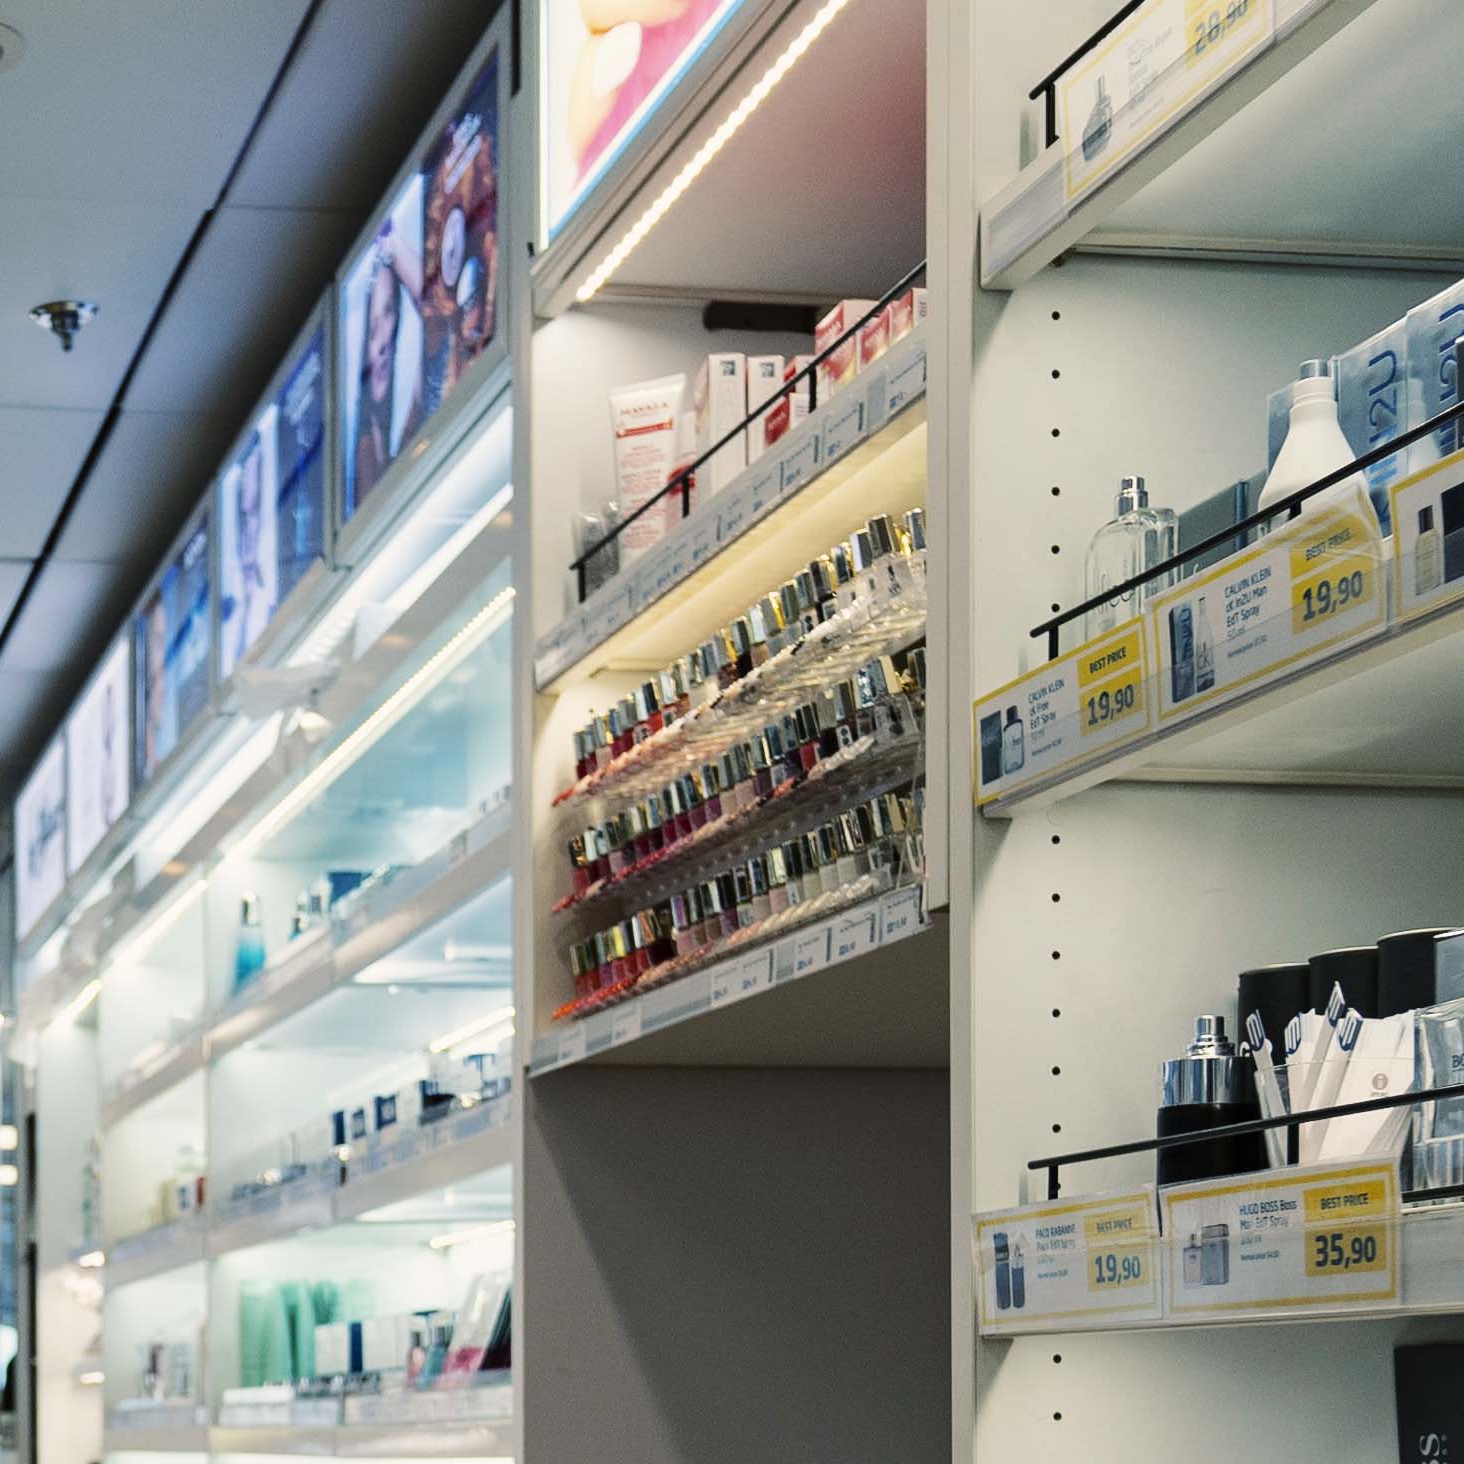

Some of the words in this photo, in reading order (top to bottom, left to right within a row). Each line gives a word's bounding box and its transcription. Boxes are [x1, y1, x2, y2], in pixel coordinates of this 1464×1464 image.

[1224, 577, 1249, 598] CALVIN
[1250, 565, 1272, 586] KLEIN
[1253, 585, 1268, 600] Man
[1303, 570, 1363, 622] 19,90
[1226, 612, 1240, 627] EdT
[1241, 604, 1261, 623] Spray
[1089, 655, 1106, 674] BEST
[1107, 646, 1127, 666] PRICE
[1088, 684, 1134, 726] 19,90
[1239, 1202, 1259, 1216] HUGO
[1260, 1200, 1278, 1214] BOSS
[1280, 1199, 1297, 1212] Boss
[1321, 1196, 1341, 1211] BEST
[1344, 1192, 1369, 1208] PRICE
[1097, 1220, 1113, 1234] BEST
[1114, 1217, 1133, 1231] PRICE
[1315, 1233, 1377, 1269] 35,90
[1095, 1254, 1141, 1285] 19,90
